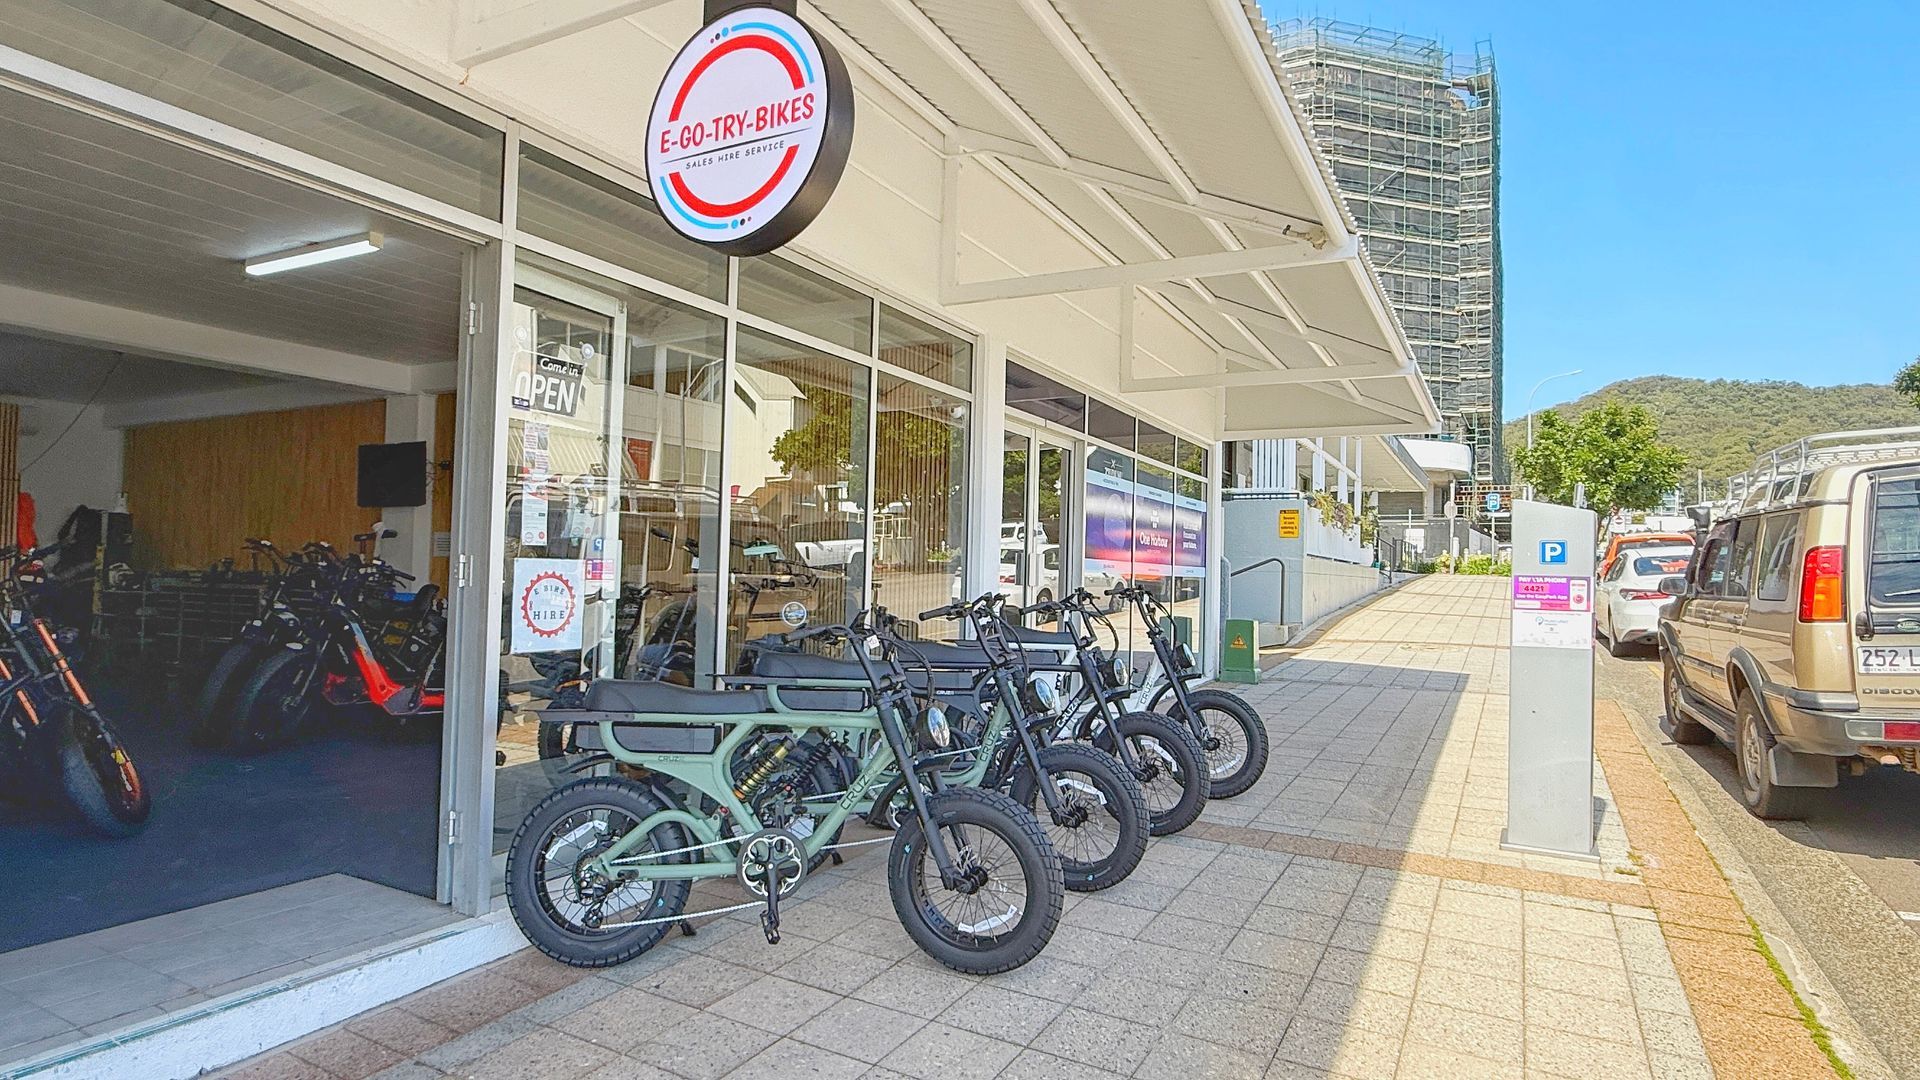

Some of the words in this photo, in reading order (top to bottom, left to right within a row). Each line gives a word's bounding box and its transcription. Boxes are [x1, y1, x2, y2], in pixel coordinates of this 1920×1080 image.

[661, 92, 815, 154] E-GO-TRY-BIKES
[685, 157, 713, 170] SALES
[718, 150, 740, 163] HIRE
[745, 140, 785, 157] SERVICE
[540, 358, 567, 375] Come
[568, 364, 579, 377] in
[514, 371, 576, 413] OPEN
[1140, 531, 1150, 546] One
[1545, 543, 1562, 562] P
[533, 610, 565, 620] HIRE
